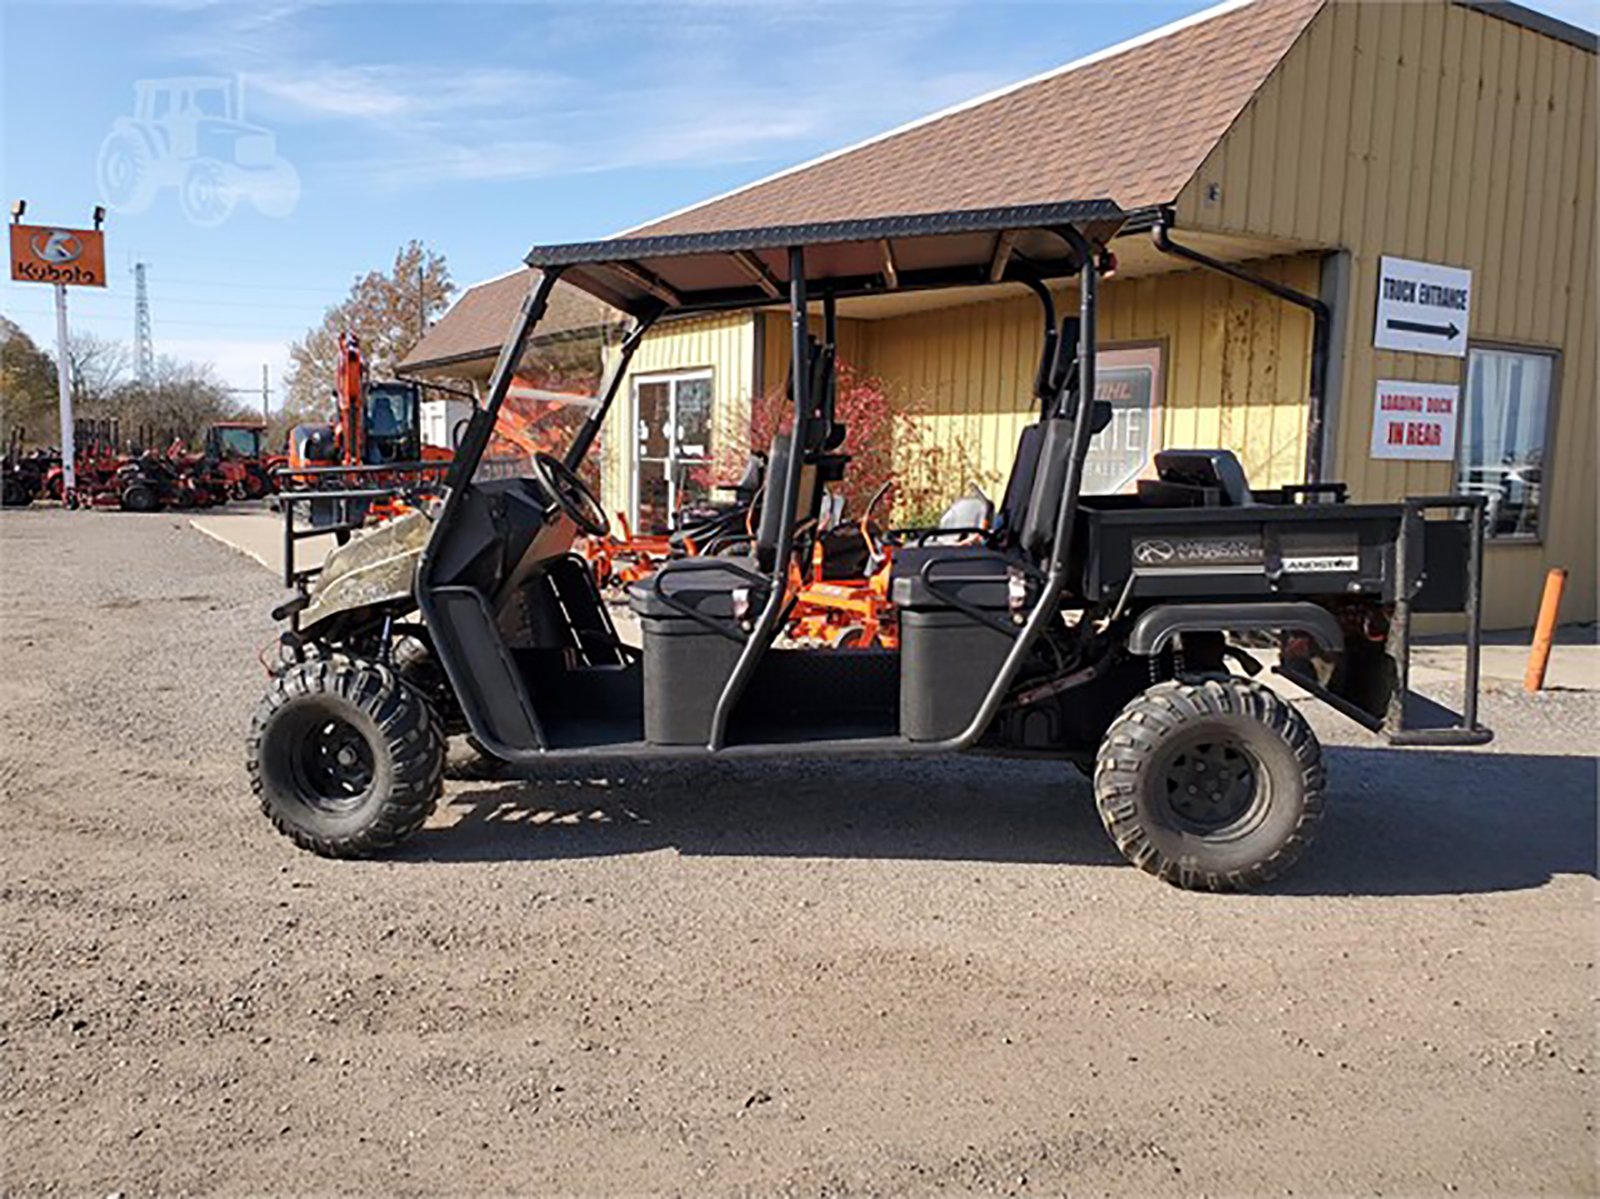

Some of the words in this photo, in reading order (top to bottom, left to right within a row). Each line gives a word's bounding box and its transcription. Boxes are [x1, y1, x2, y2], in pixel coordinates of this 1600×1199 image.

[18, 262, 94, 282] Kubota
[1384, 277, 1417, 303] TRUCK
[1419, 283, 1467, 310] ENTRANCE
[1380, 394, 1424, 412] LOADING
[1426, 397, 1453, 414] DOCK
[1388, 422, 1405, 445] IN
[1406, 422, 1443, 446] REAR
